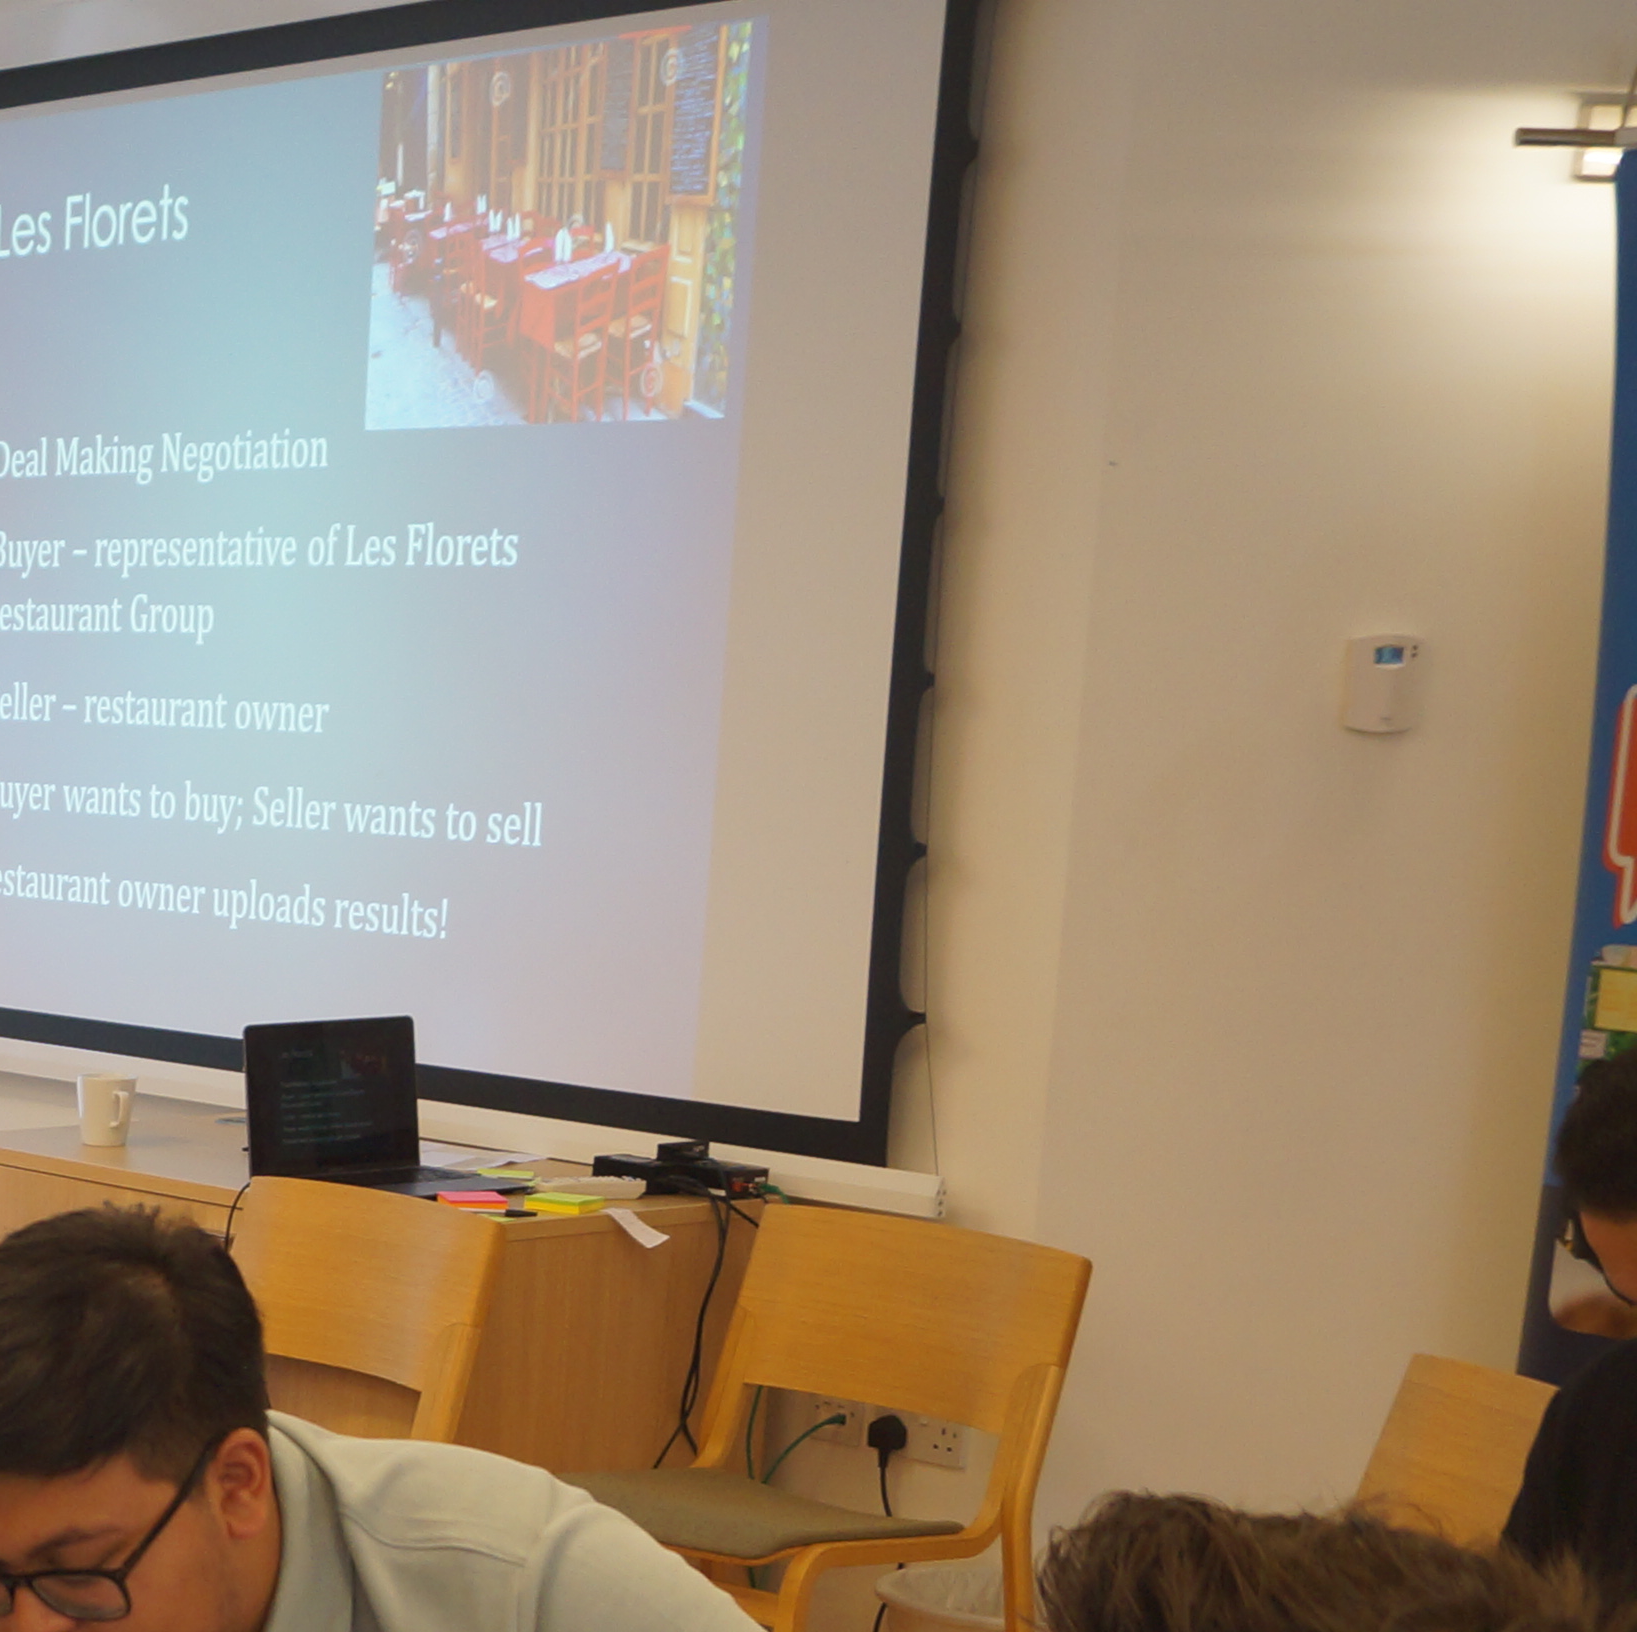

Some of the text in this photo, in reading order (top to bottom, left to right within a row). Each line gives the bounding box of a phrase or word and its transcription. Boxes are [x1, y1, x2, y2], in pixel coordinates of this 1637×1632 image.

[64, 183, 189, 251] Florets
[55, 432, 154, 485] Making
[160, 428, 328, 483] Negotiation
[94, 526, 297, 578] representative
[307, 522, 341, 566] of
[345, 524, 397, 566] Les
[405, 521, 519, 566] Florets
[130, 593, 214, 645] Group
[83, 690, 228, 729] restaurant
[235, 701, 330, 733] owner
[63, 782, 142, 817] wants
[149, 784, 176, 819] to
[184, 780, 243, 834] buy;
[252, 786, 336, 830] Seller
[343, 800, 436, 838] wants
[446, 803, 477, 841] to
[486, 801, 542, 846] sell
[118, 880, 207, 915] owner
[212, 885, 326, 929] uploads
[334, 892, 448, 939] results!
